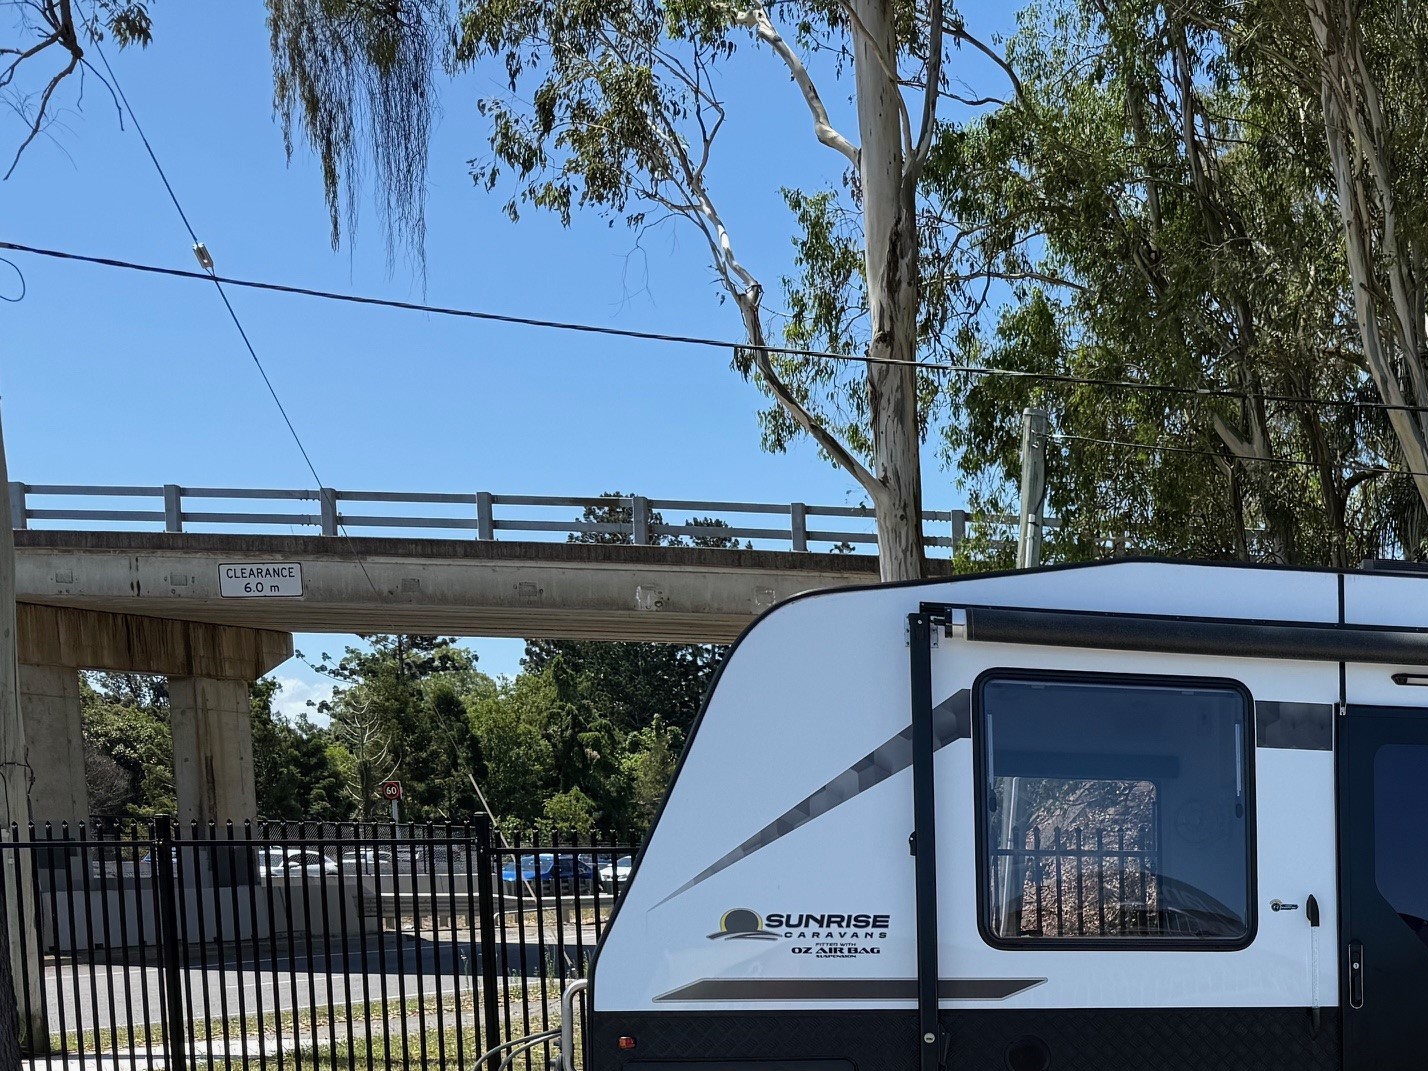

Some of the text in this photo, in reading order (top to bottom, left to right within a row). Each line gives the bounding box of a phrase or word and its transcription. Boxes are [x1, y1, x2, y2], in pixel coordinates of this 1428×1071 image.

[226, 567, 295, 579] CLEARANCE
[244, 581, 280, 593] 6.0 m
[386, 786, 397, 795] 60
[765, 913, 891, 929] SUNRISE
[784, 931, 888, 939] CARAVANS
